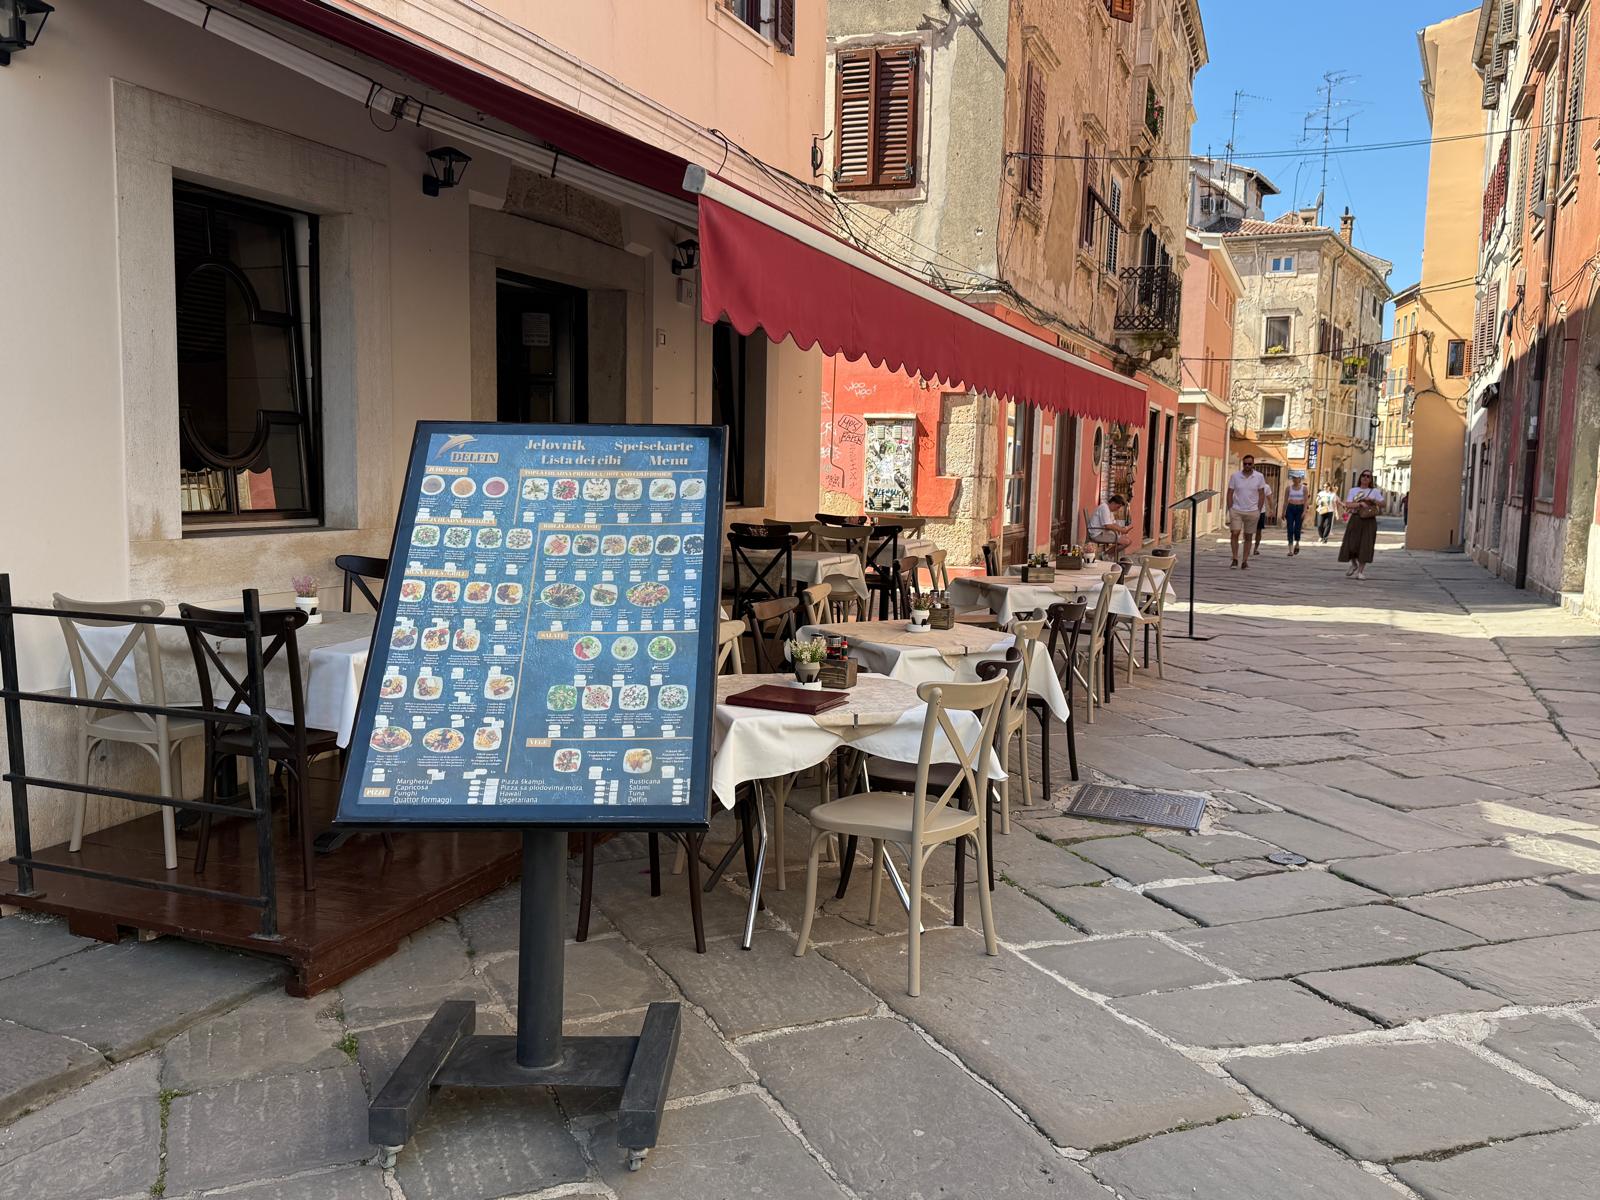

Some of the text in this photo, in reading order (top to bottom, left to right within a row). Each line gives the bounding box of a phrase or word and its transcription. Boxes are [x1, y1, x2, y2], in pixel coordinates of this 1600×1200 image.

[525, 439, 694, 453] Jelovnik Speisekarte
[452, 452, 498, 463] DELFIN
[541, 454, 689, 466] Lista dei cibi Menu
[396, 778, 433, 786] Margherita
[395, 784, 429, 792] Capricosa
[528, 784, 564, 792] plodovima
[421, 795, 452, 805] formaggi
[627, 796, 648, 804] Delfin
